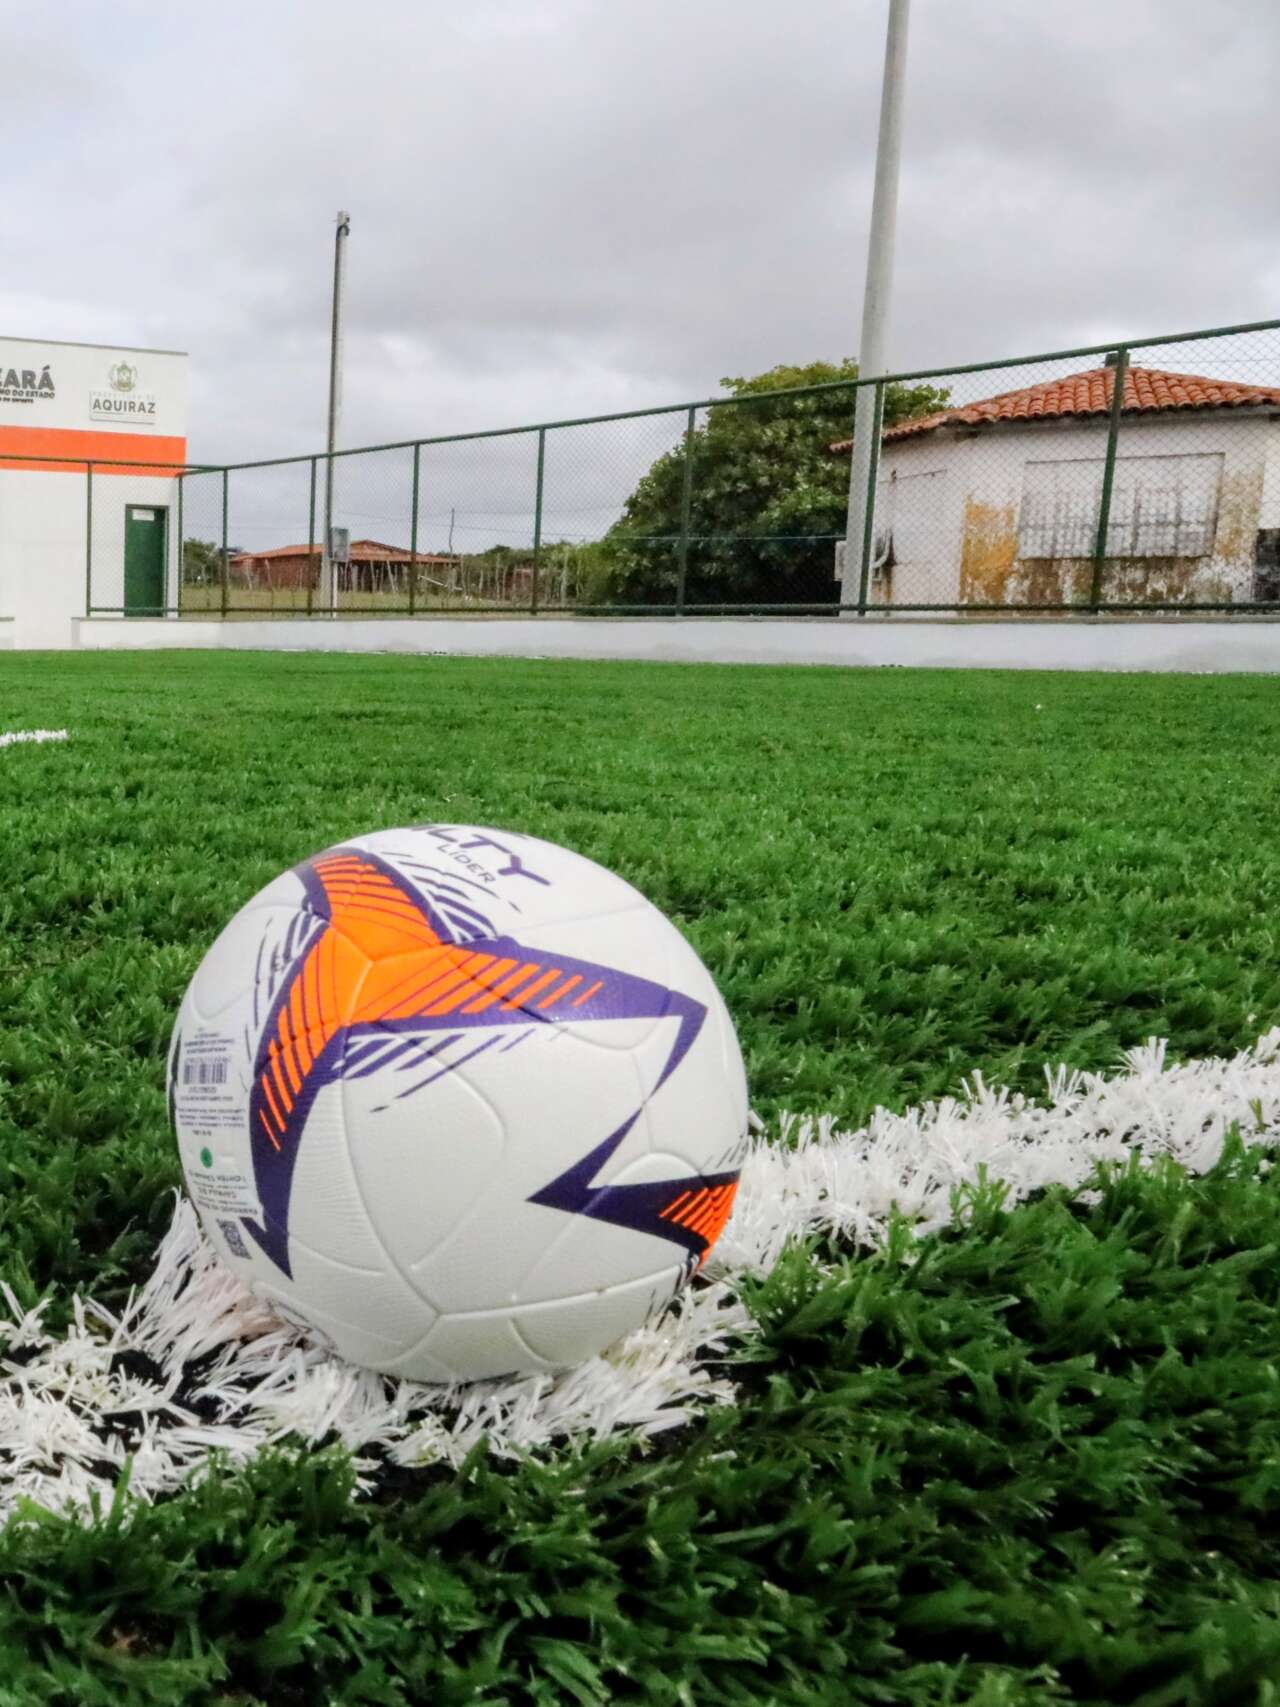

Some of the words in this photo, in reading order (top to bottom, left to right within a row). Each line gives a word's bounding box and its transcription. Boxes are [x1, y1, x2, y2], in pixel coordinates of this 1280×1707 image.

[12, 388, 24, 397] DO
[25, 390, 55, 399] ESTADO
[92, 398, 156, 414] AQUIRAZ
